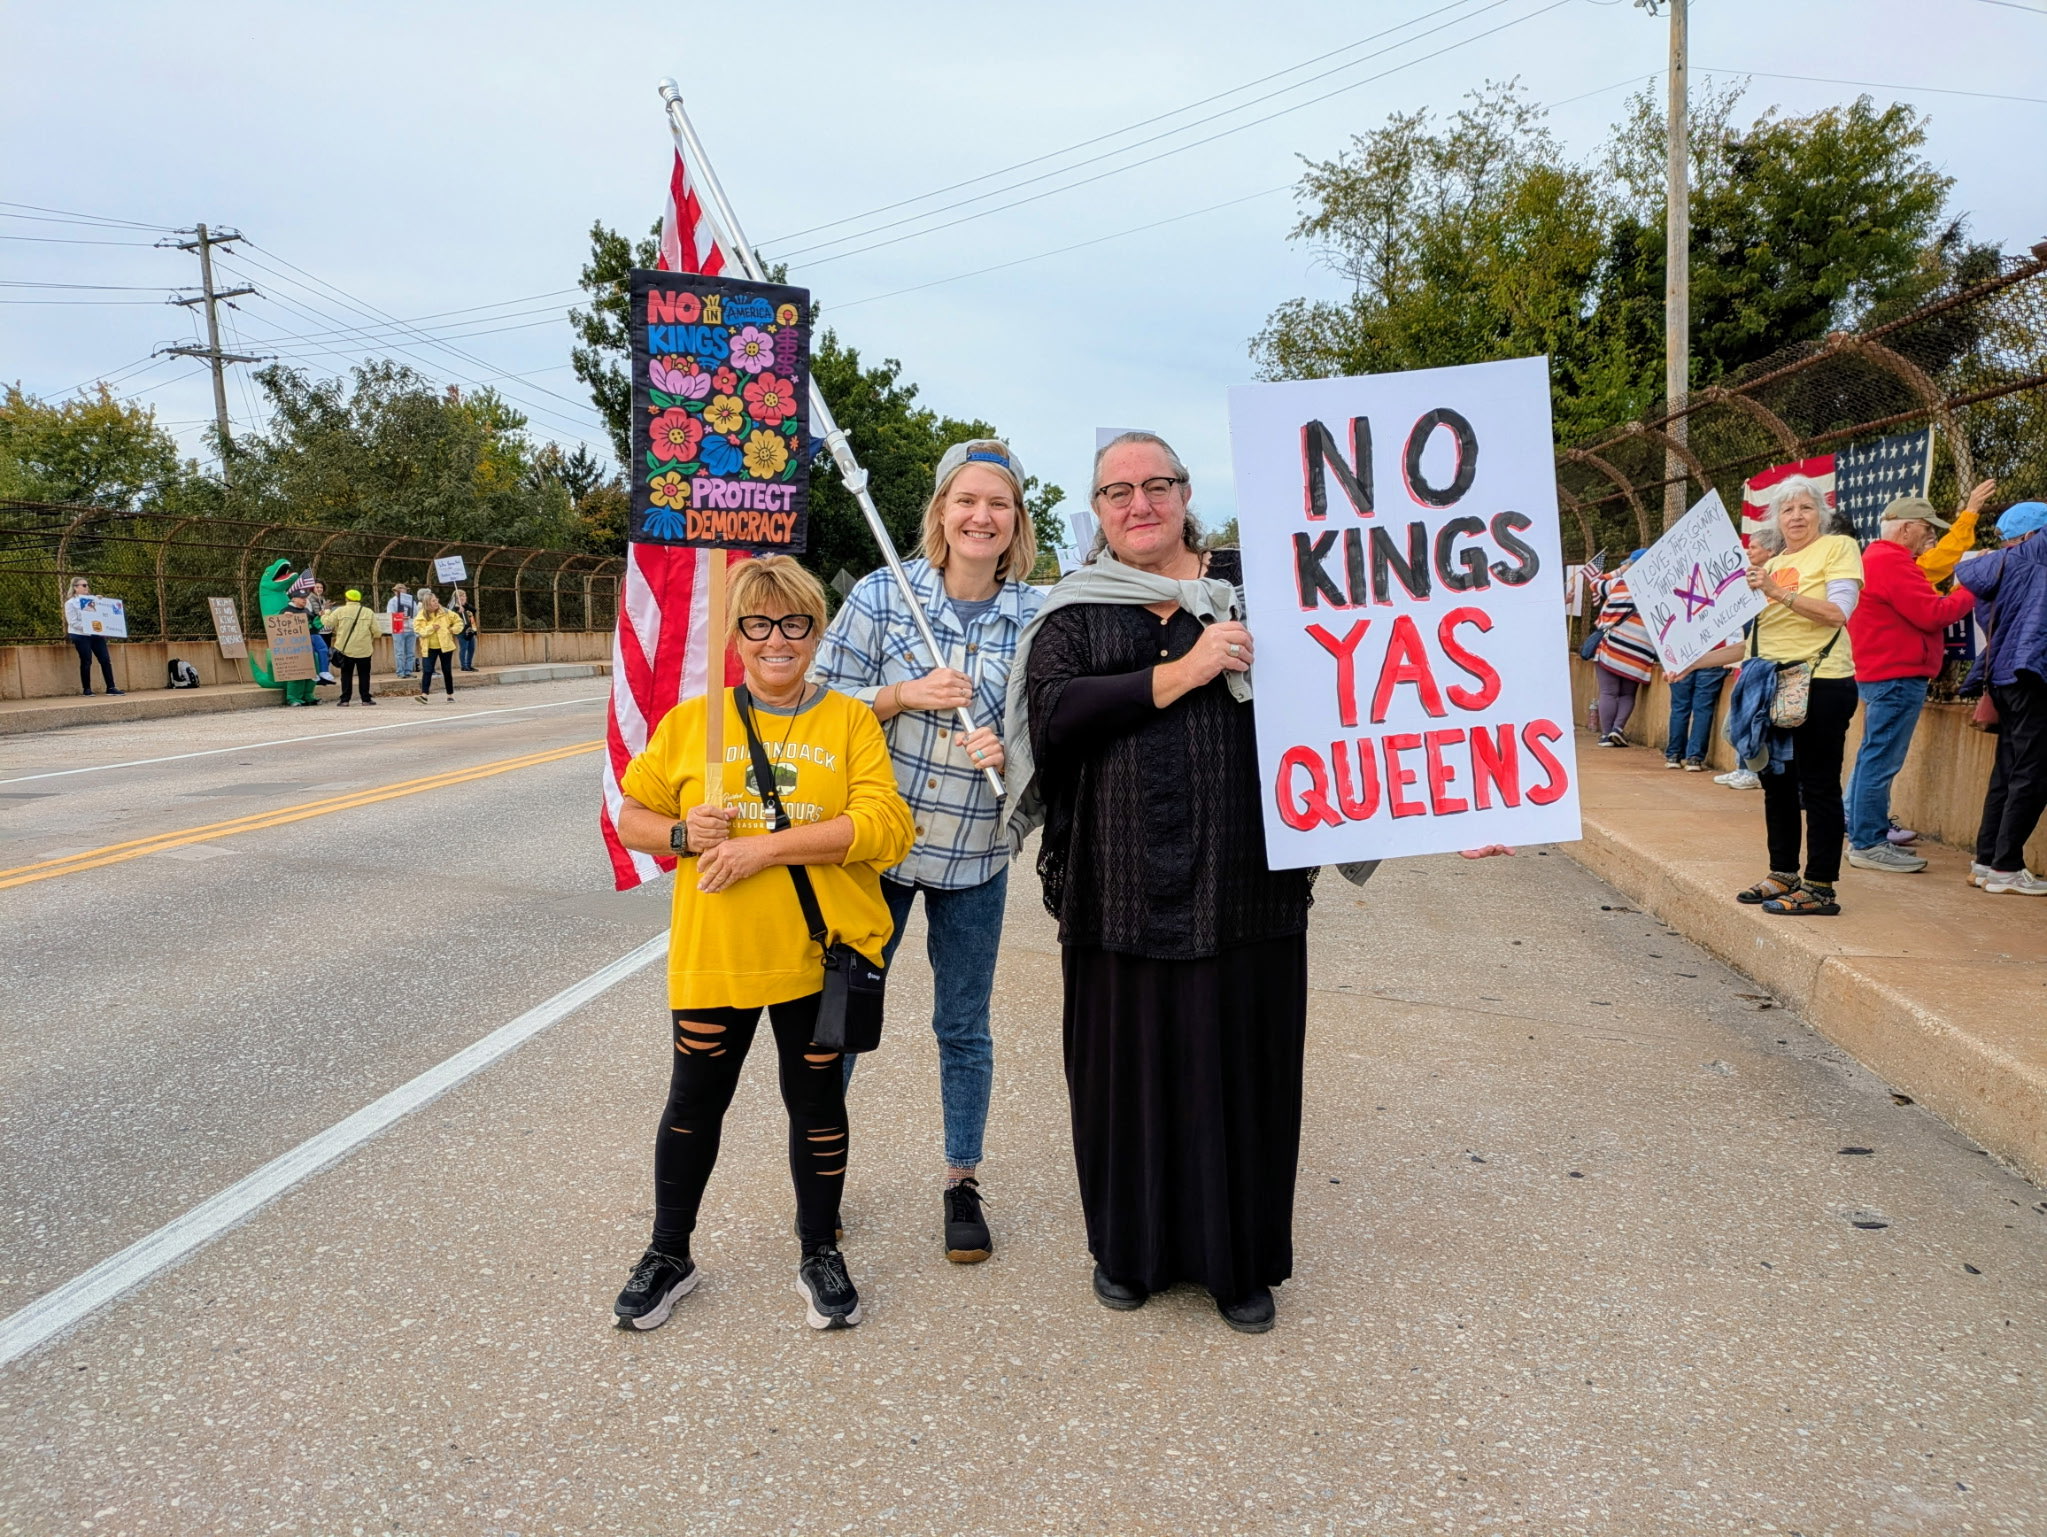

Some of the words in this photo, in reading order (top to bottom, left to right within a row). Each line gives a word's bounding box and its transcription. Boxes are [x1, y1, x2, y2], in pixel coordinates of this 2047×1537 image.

[647, 289, 701, 324] NO
[706, 309, 719, 322] IN
[727, 307, 773, 320] AMERICA
[647, 324, 729, 359] KINGS
[1300, 407, 1479, 521] NO
[692, 477, 797, 511] PROTECT
[685, 509, 798, 543] DEMOCRACY
[1292, 510, 1540, 612] KINGS
[1692, 533, 1711, 556] SAY
[1642, 550, 1670, 586] LOVE
[1650, 602, 1672, 636] NO
[1704, 545, 1743, 590] KINGS
[268, 617, 291, 629] Stop
[294, 615, 306, 625] the
[276, 626, 302, 636] Steal
[1680, 642, 1698, 664] ALL
[1700, 627, 1715, 644] ARE
[1305, 606, 1502, 727] YAS
[725, 741, 836, 773] DIONDACK
[1275, 718, 1569, 832] QUEENS
[726, 801, 766, 820] ANOE
[781, 802, 824, 822] OURS
